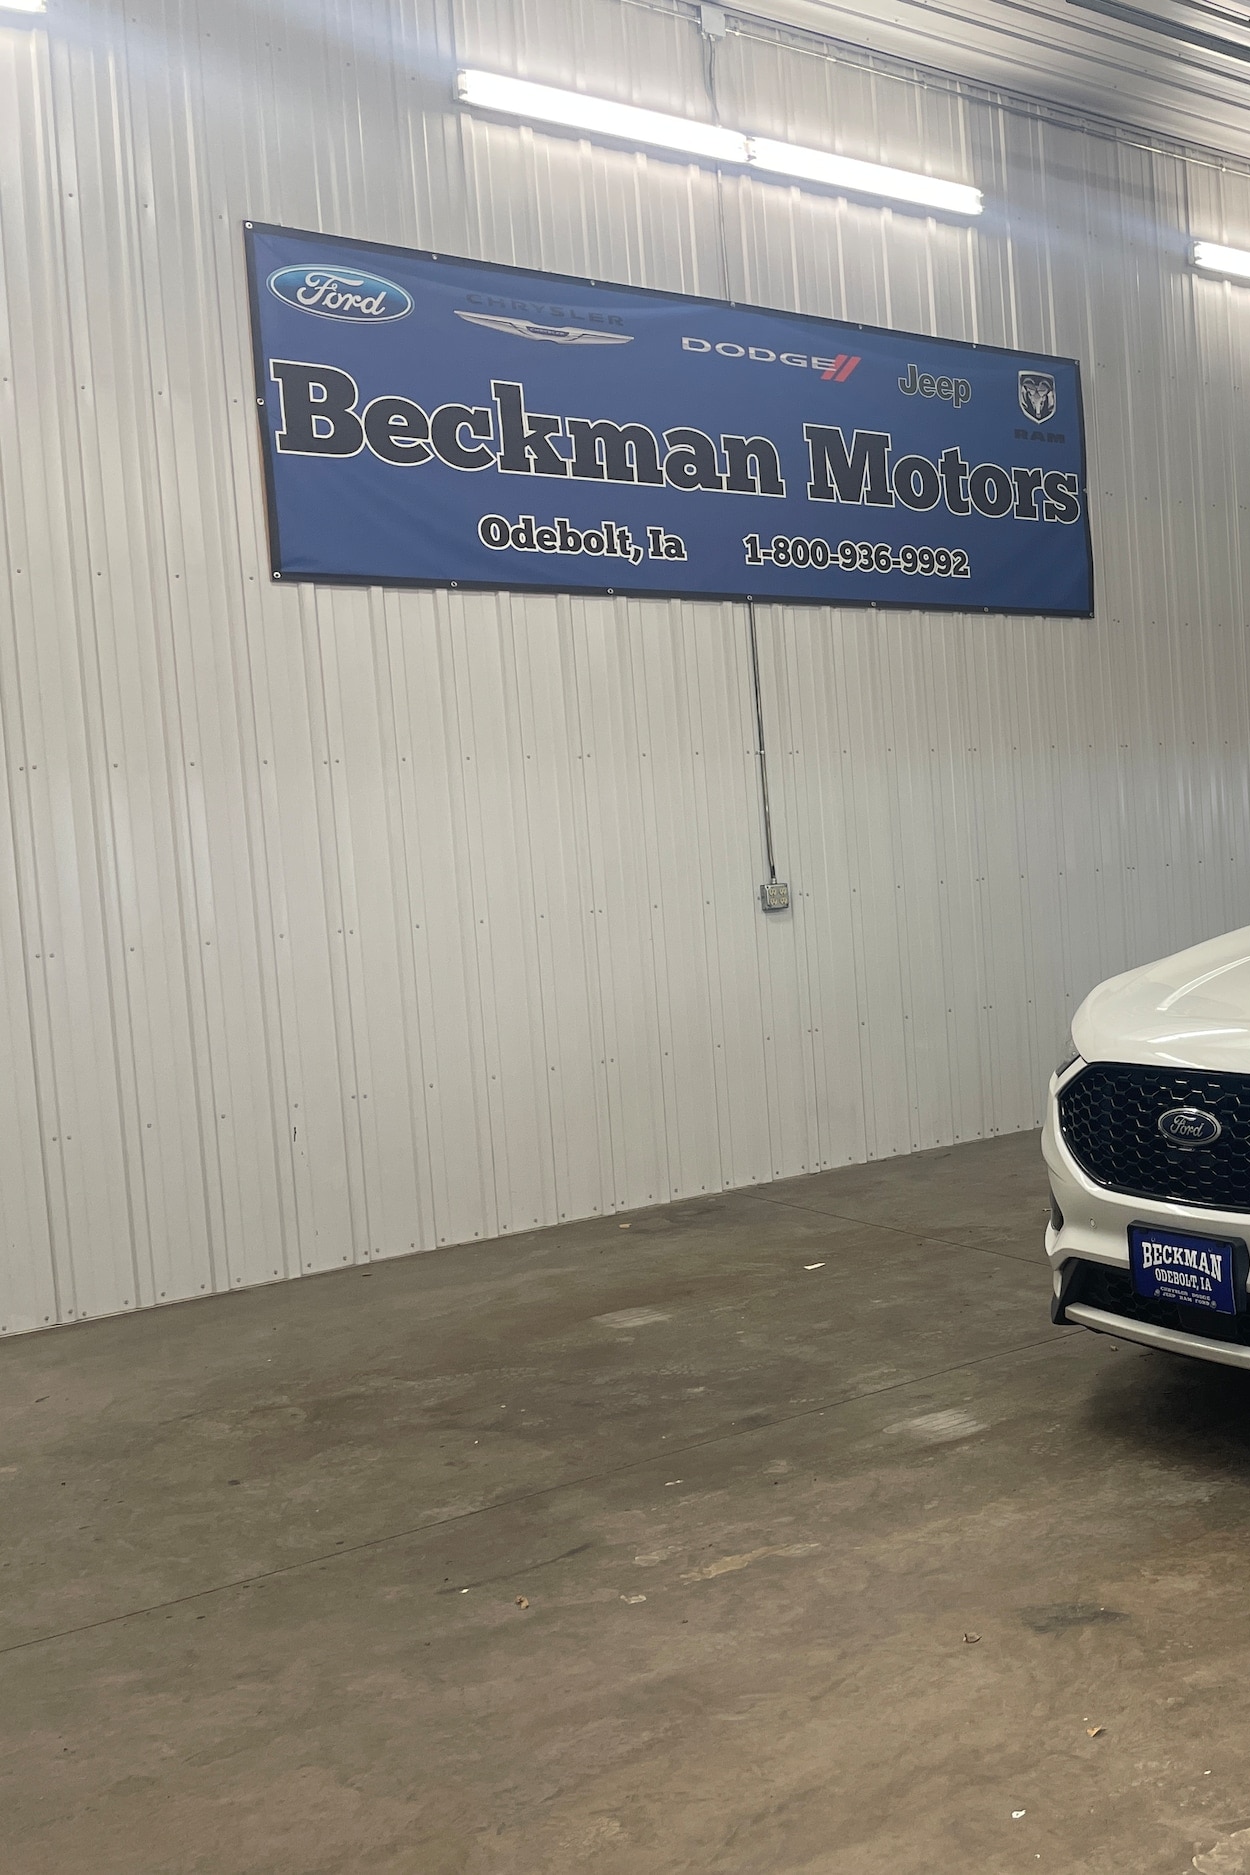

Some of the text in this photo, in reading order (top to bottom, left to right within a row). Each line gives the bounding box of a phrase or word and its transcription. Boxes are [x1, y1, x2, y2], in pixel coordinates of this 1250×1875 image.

[296, 271, 387, 316] Ford
[465, 293, 625, 327] CHRYSLER
[681, 336, 838, 371] DODGE
[898, 364, 971, 408] Jeep
[269, 358, 1081, 524] Beckman Motors
[1013, 428, 1066, 444] RAM
[477, 514, 688, 565] Odebolt, Ia
[742, 533, 971, 579] 1-800-936-9992
[1169, 1114, 1205, 1138] Ford
[1141, 1241, 1222, 1283] BECKMAN
